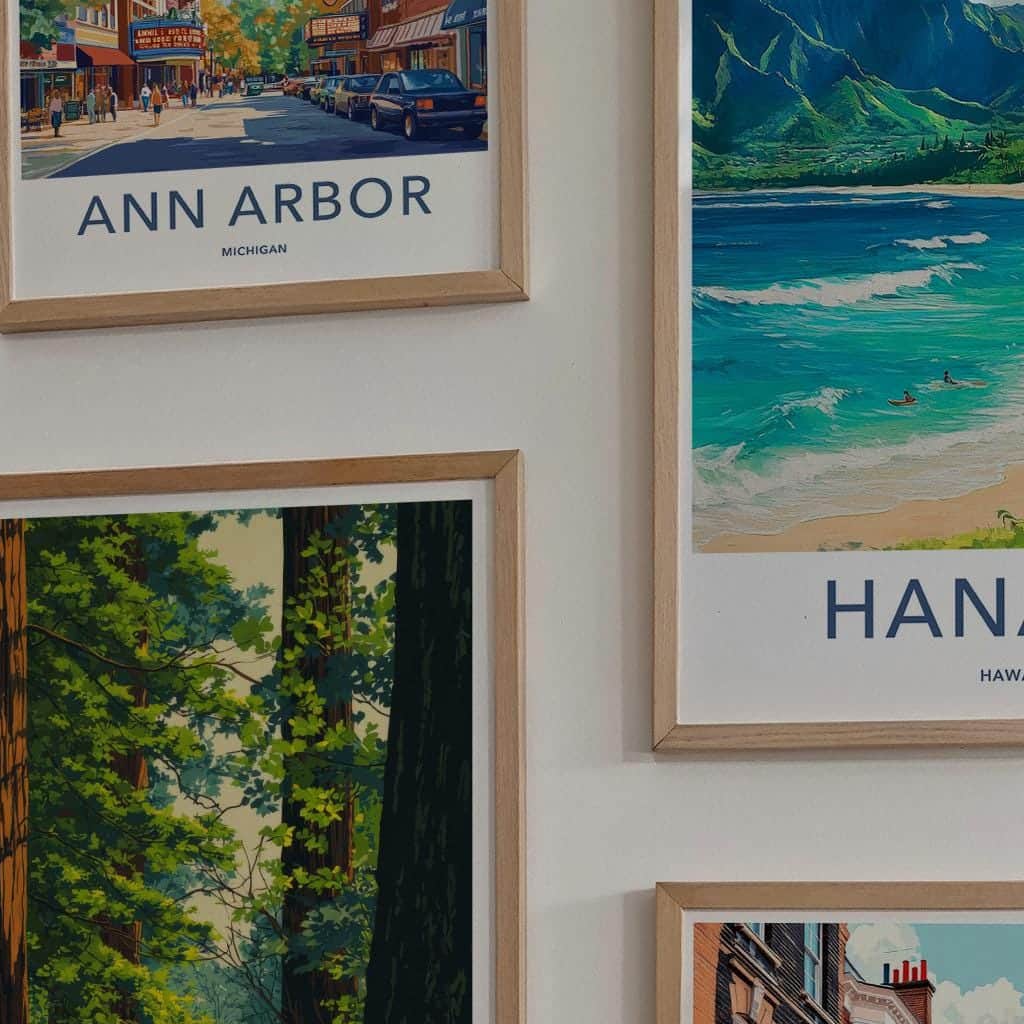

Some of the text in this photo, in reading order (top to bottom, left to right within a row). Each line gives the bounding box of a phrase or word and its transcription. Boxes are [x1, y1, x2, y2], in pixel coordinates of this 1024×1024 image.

[77, 175, 433, 236] ANN ARBOR
[222, 243, 288, 257] MICHIGAN
[827, 577, 1024, 639] HAN
[980, 669, 1024, 682] HAW
